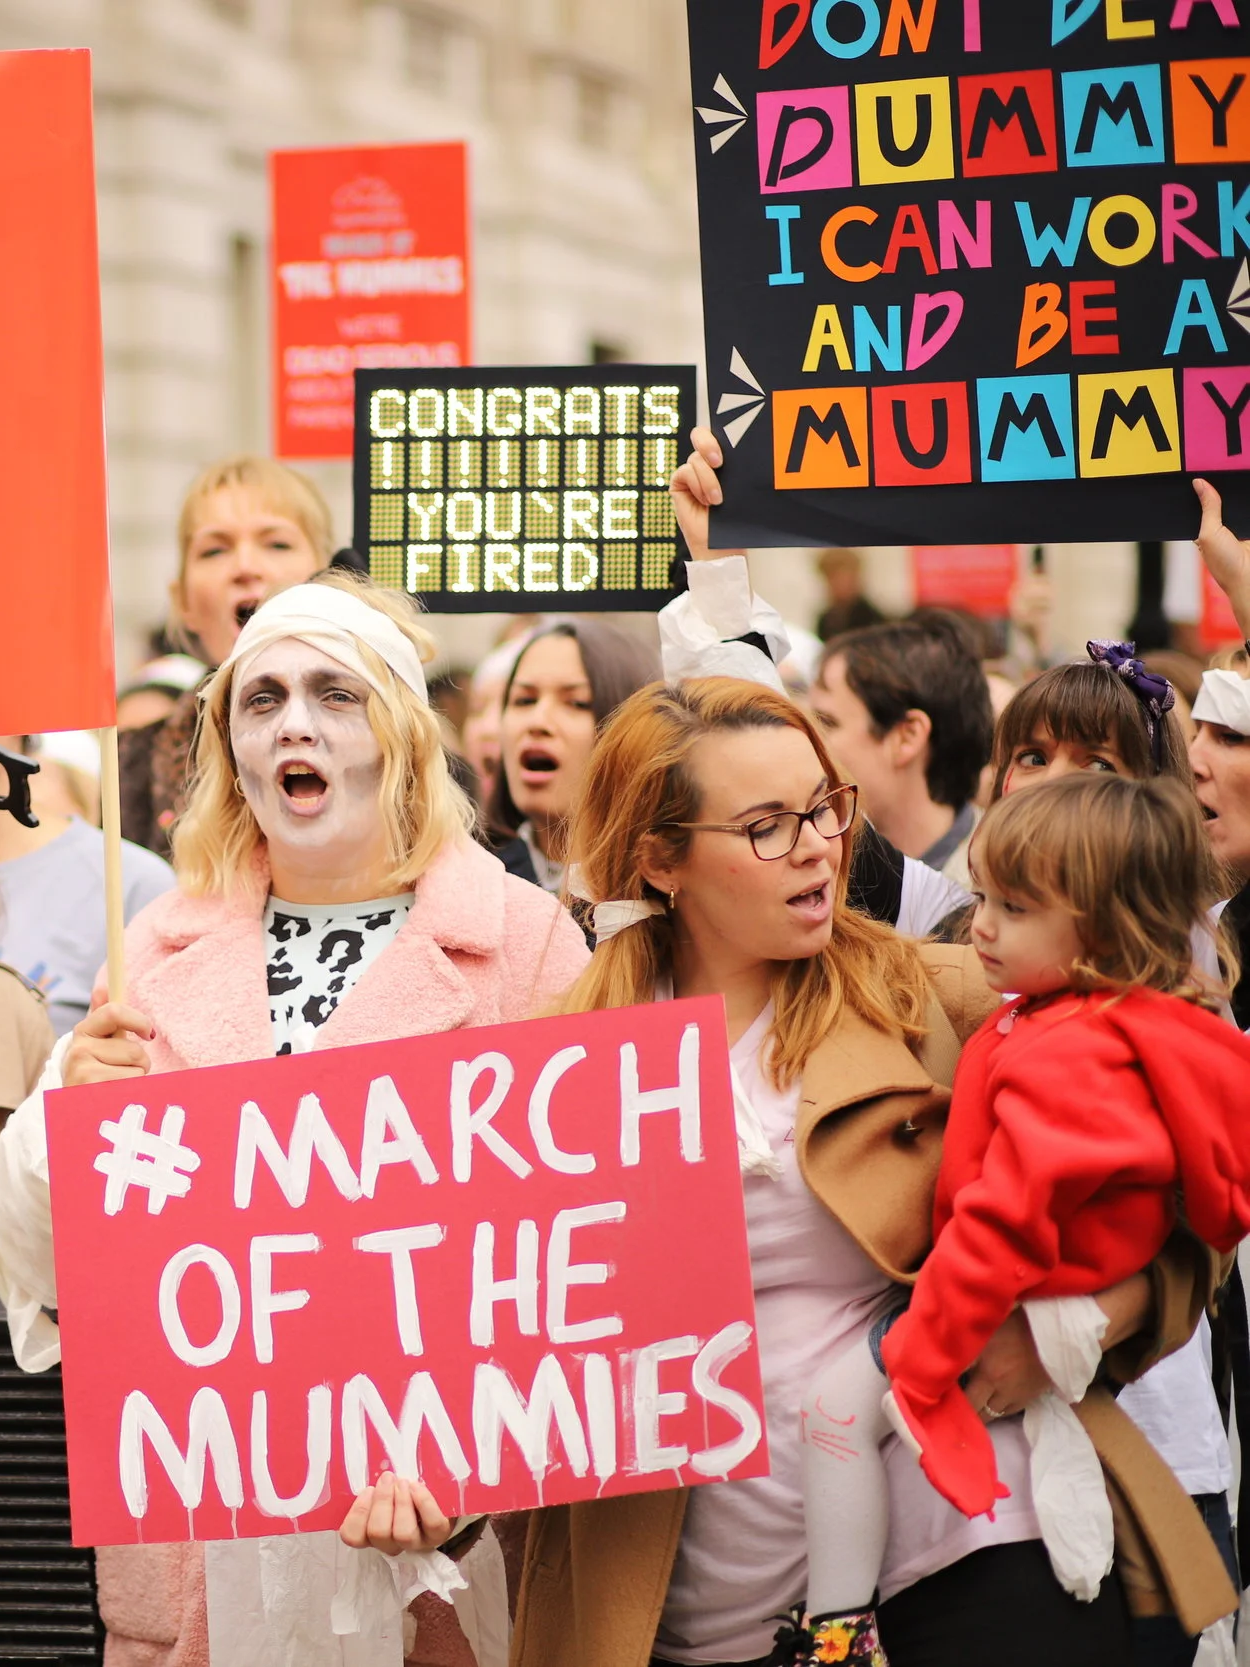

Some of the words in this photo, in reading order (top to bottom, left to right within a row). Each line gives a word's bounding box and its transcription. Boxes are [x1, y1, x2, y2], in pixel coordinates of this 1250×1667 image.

[764, 73, 1248, 187] DUMMY
[765, 204, 804, 286] I
[820, 200, 992, 282] CAN
[1015, 181, 1250, 268] WORK
[802, 290, 964, 372] AND
[1015, 280, 1120, 369] BE
[1163, 279, 1229, 355] A
[370, 386, 680, 437] CONGRATS
[784, 382, 1250, 474] MUMMY
[406, 543, 599, 593] FIRED
[158, 1232, 322, 1367] OF
[353, 1201, 627, 1357] THE
[118, 1321, 762, 1522] MUMMIES
